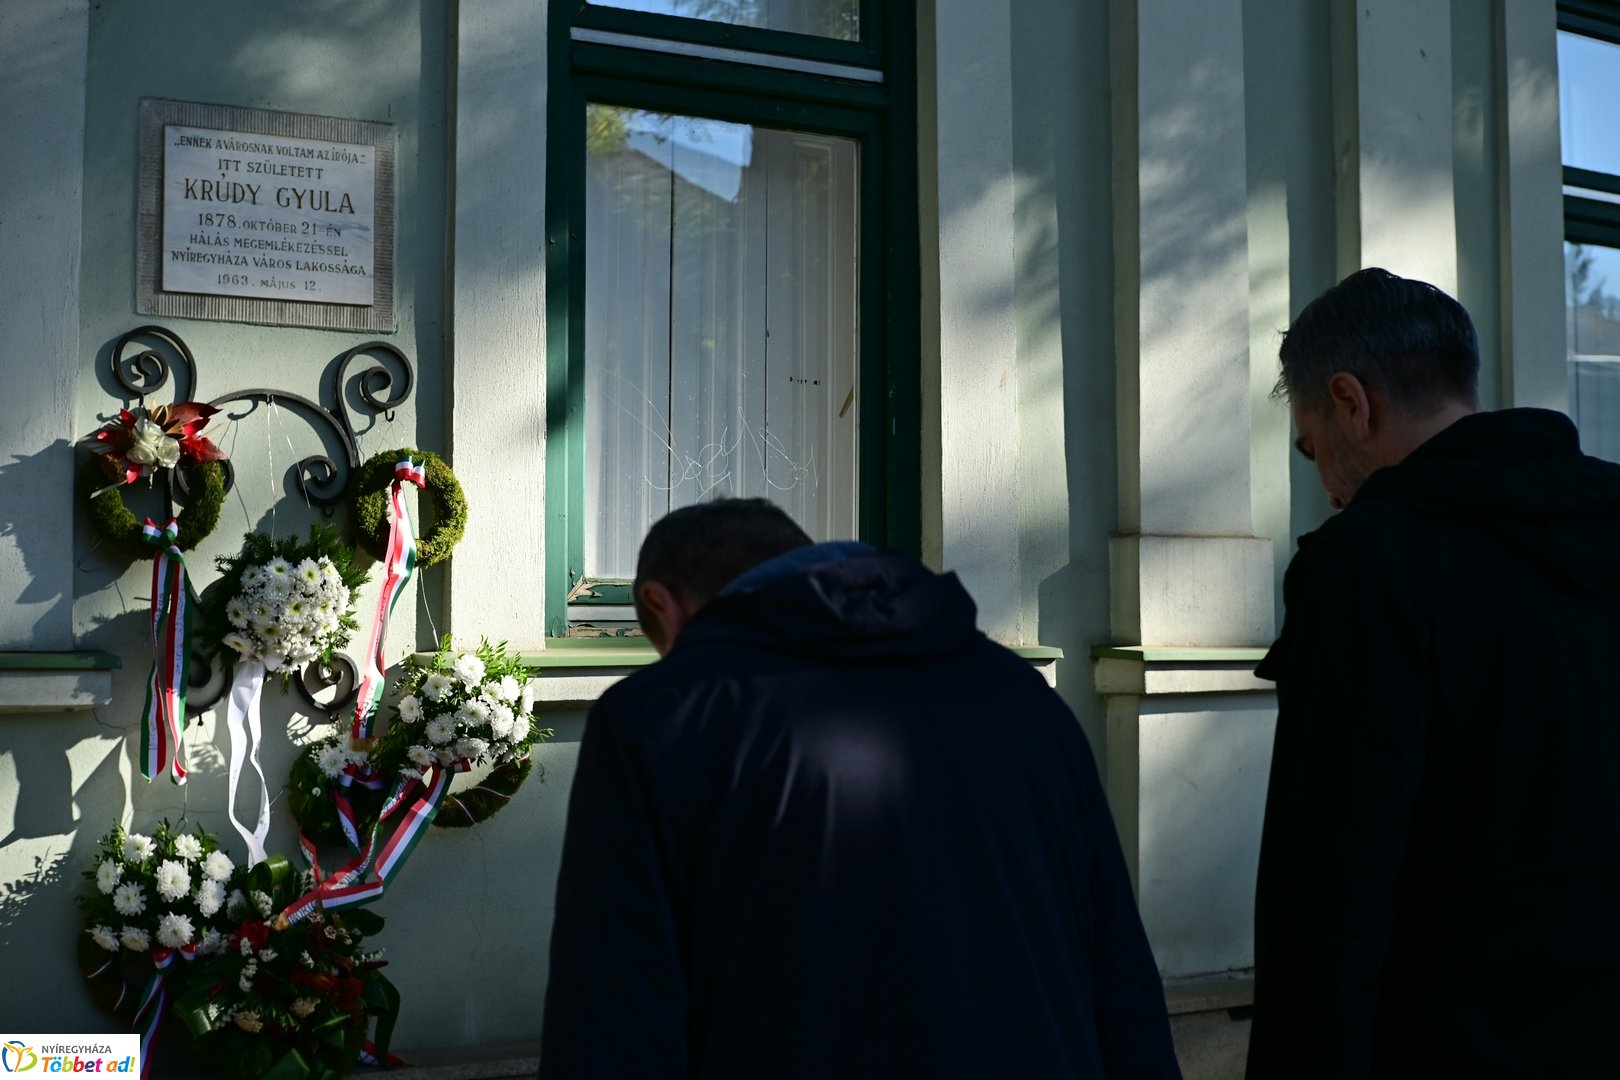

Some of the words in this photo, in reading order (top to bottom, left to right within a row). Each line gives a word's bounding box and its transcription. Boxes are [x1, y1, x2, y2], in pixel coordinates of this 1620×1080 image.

[276, 145, 314, 159] VOLTAM
[218, 158, 241, 171] ITT
[246, 159, 323, 180] SZÜLETETT
[184, 172, 261, 206] KRÚDY
[276, 187, 355, 214] GYULA
[242, 218, 297, 234] OKTÓBER
[189, 230, 230, 247] HÁLÁS
[233, 237, 348, 257] MEGEMLÉKEZÉSSEL
[171, 246, 248, 267] NYÍREGYHÁZA
[252, 252, 292, 269] VÁROS
[295, 259, 366, 275] LAKOSSÁGA
